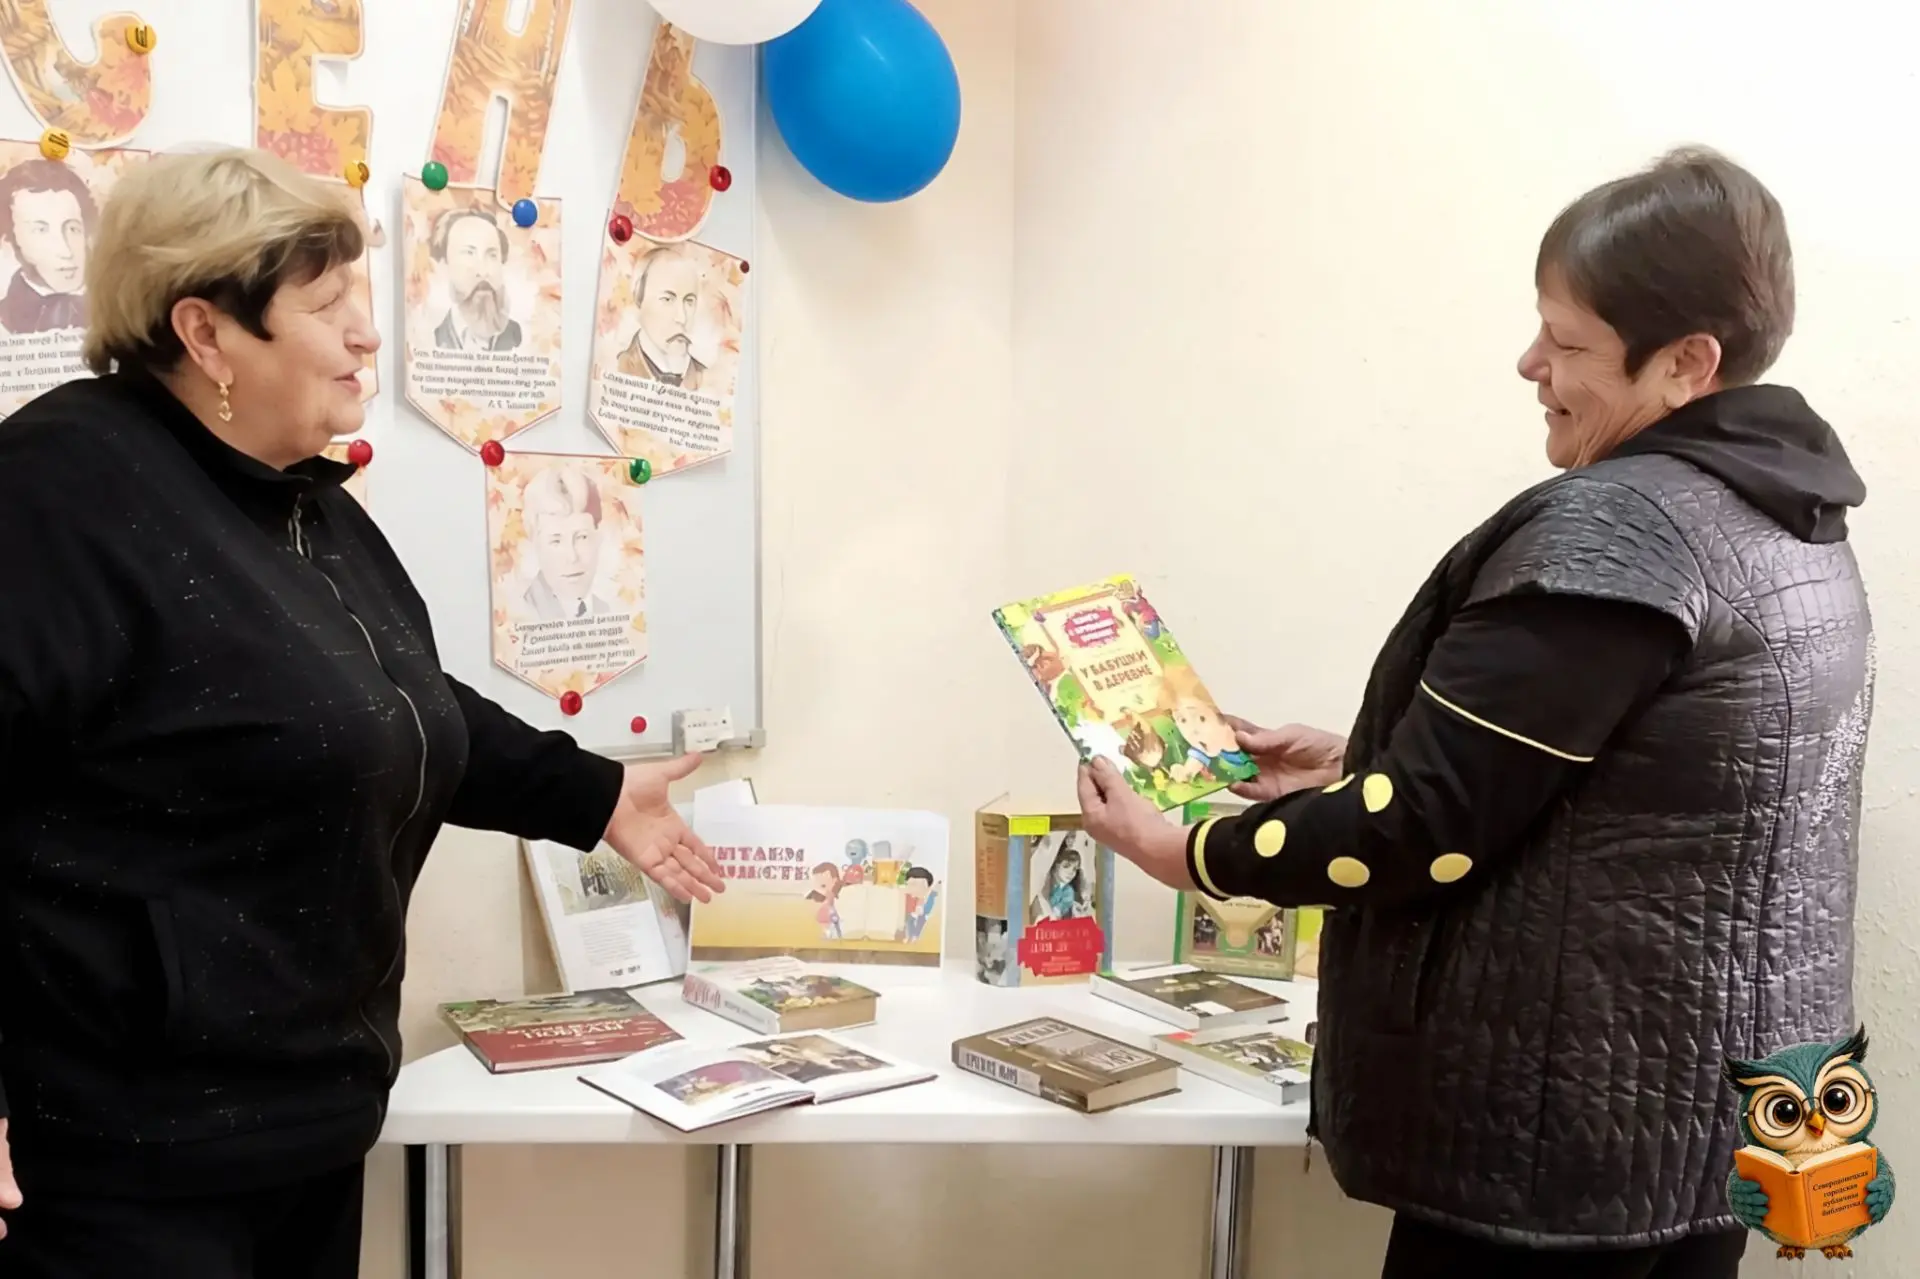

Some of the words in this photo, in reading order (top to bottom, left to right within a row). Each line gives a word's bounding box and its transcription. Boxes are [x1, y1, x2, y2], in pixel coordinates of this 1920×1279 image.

[1090, 650, 1148, 675] БАБУШКИ
[1092, 679, 1103, 692] В
[1105, 664, 1154, 689] ДЕРЕВНЕ
[712, 846, 805, 862] ИТАЕМ
